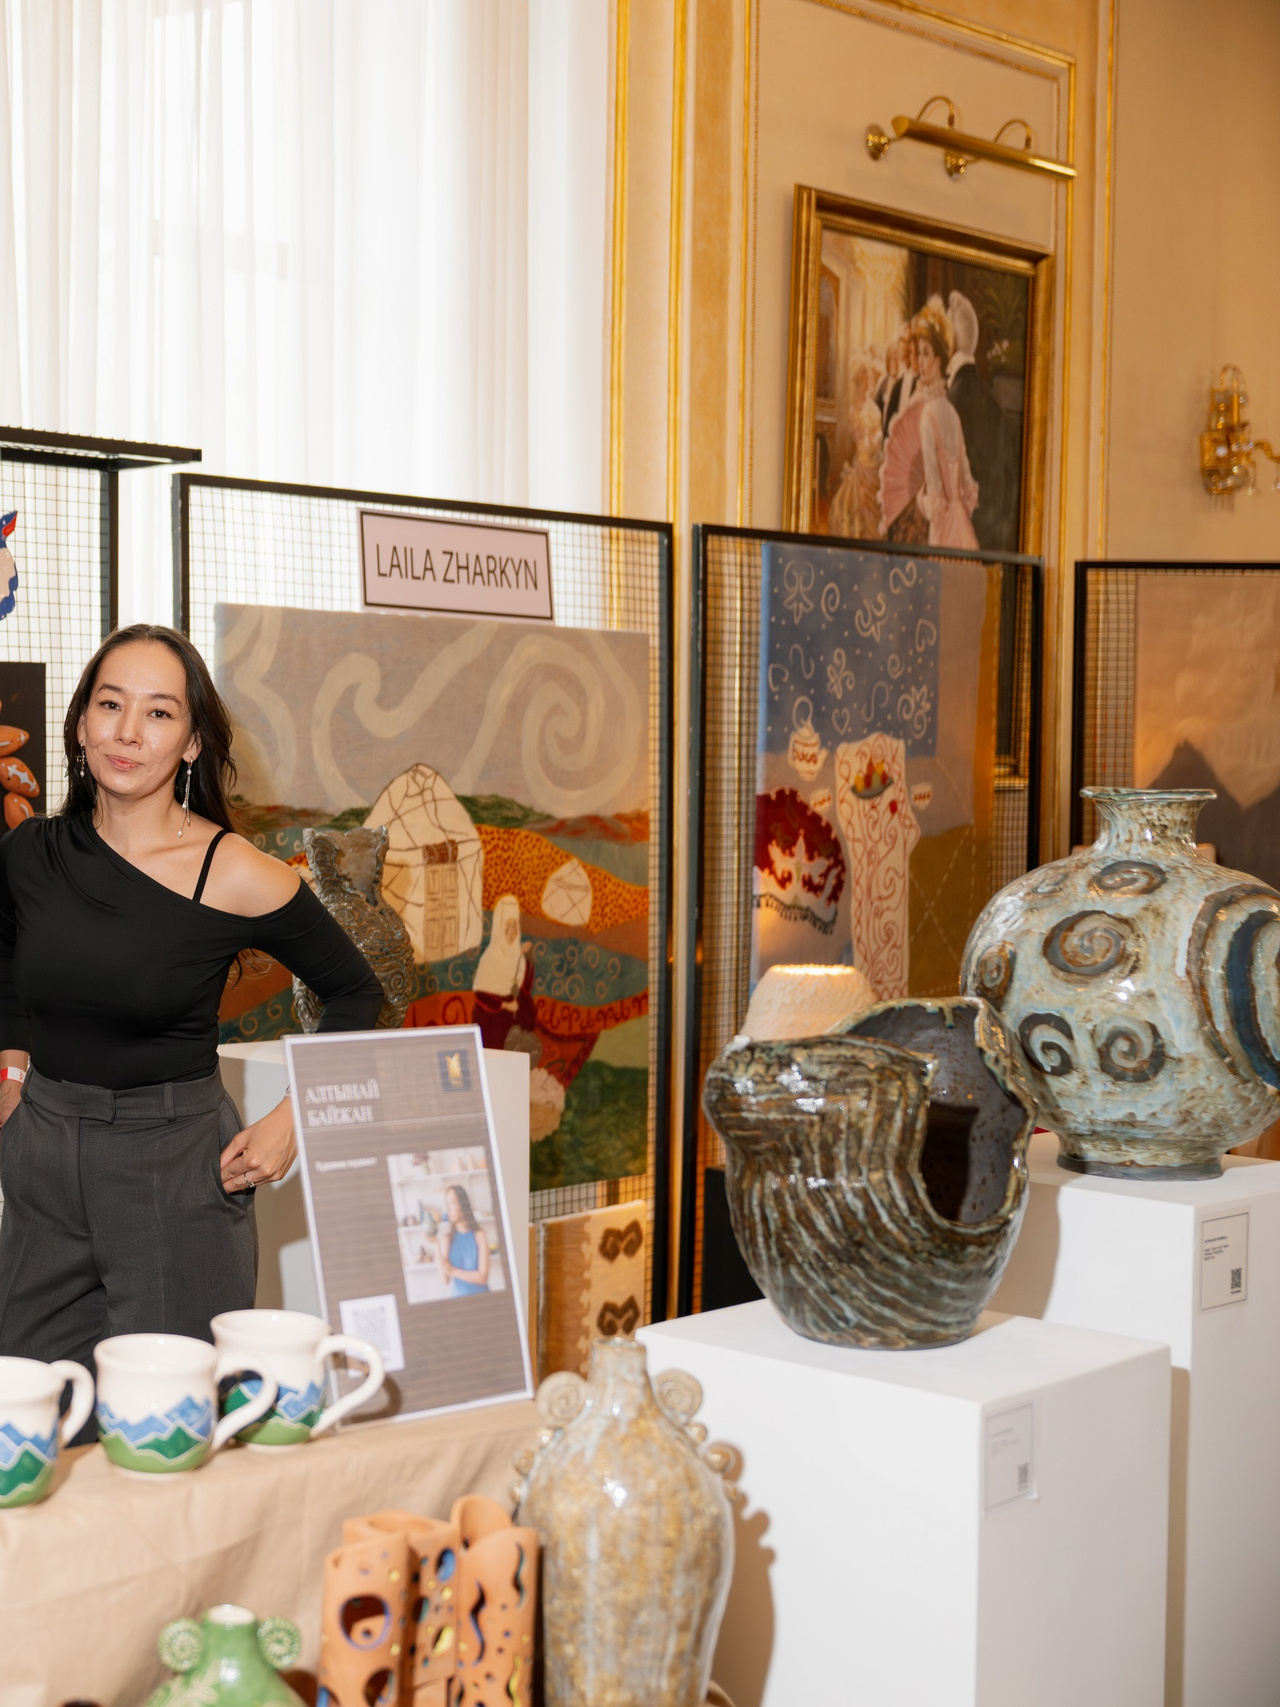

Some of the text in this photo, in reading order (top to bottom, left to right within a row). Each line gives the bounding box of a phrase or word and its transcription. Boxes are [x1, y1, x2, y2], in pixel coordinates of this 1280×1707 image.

[376, 543, 538, 591] LAILA ZHARKYN
[305, 1078, 380, 1104] АЛТЫНАЙ
